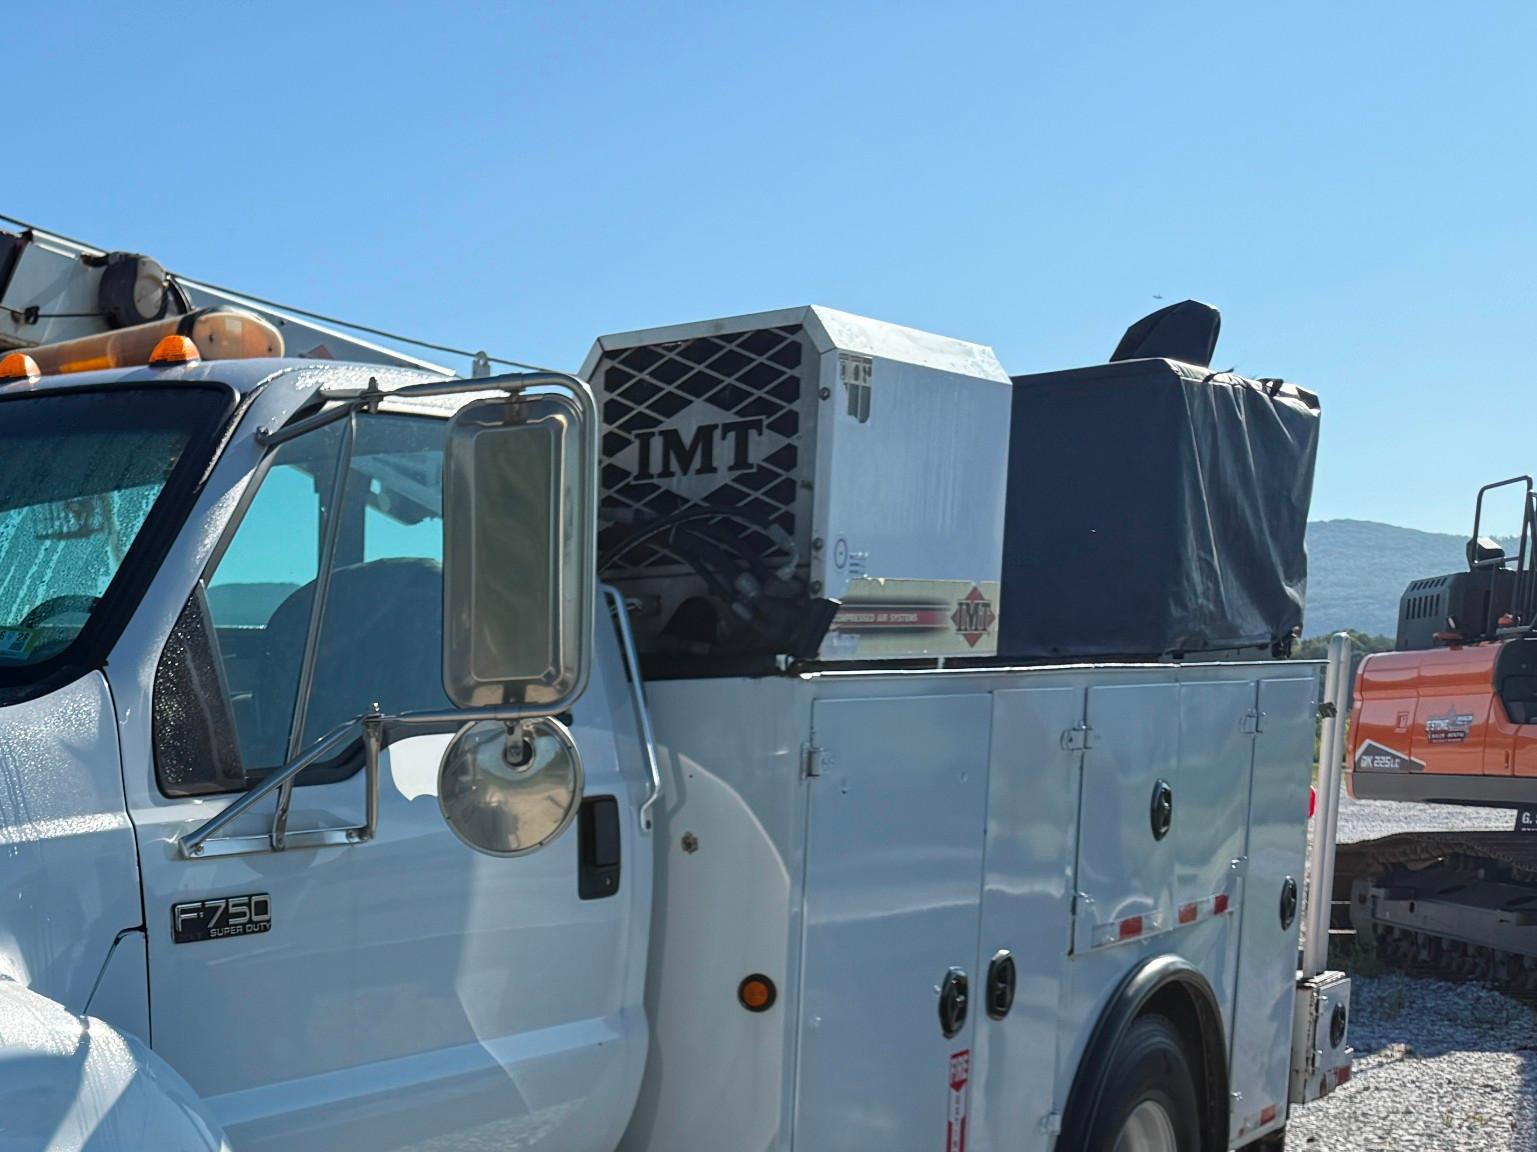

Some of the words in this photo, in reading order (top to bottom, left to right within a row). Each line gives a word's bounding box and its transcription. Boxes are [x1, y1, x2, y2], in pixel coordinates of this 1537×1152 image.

[633, 418, 764, 482] IMT
[956, 602, 991, 632] IMT
[210, 926, 243, 938] SUPER
[245, 921, 272, 933] DUTY
